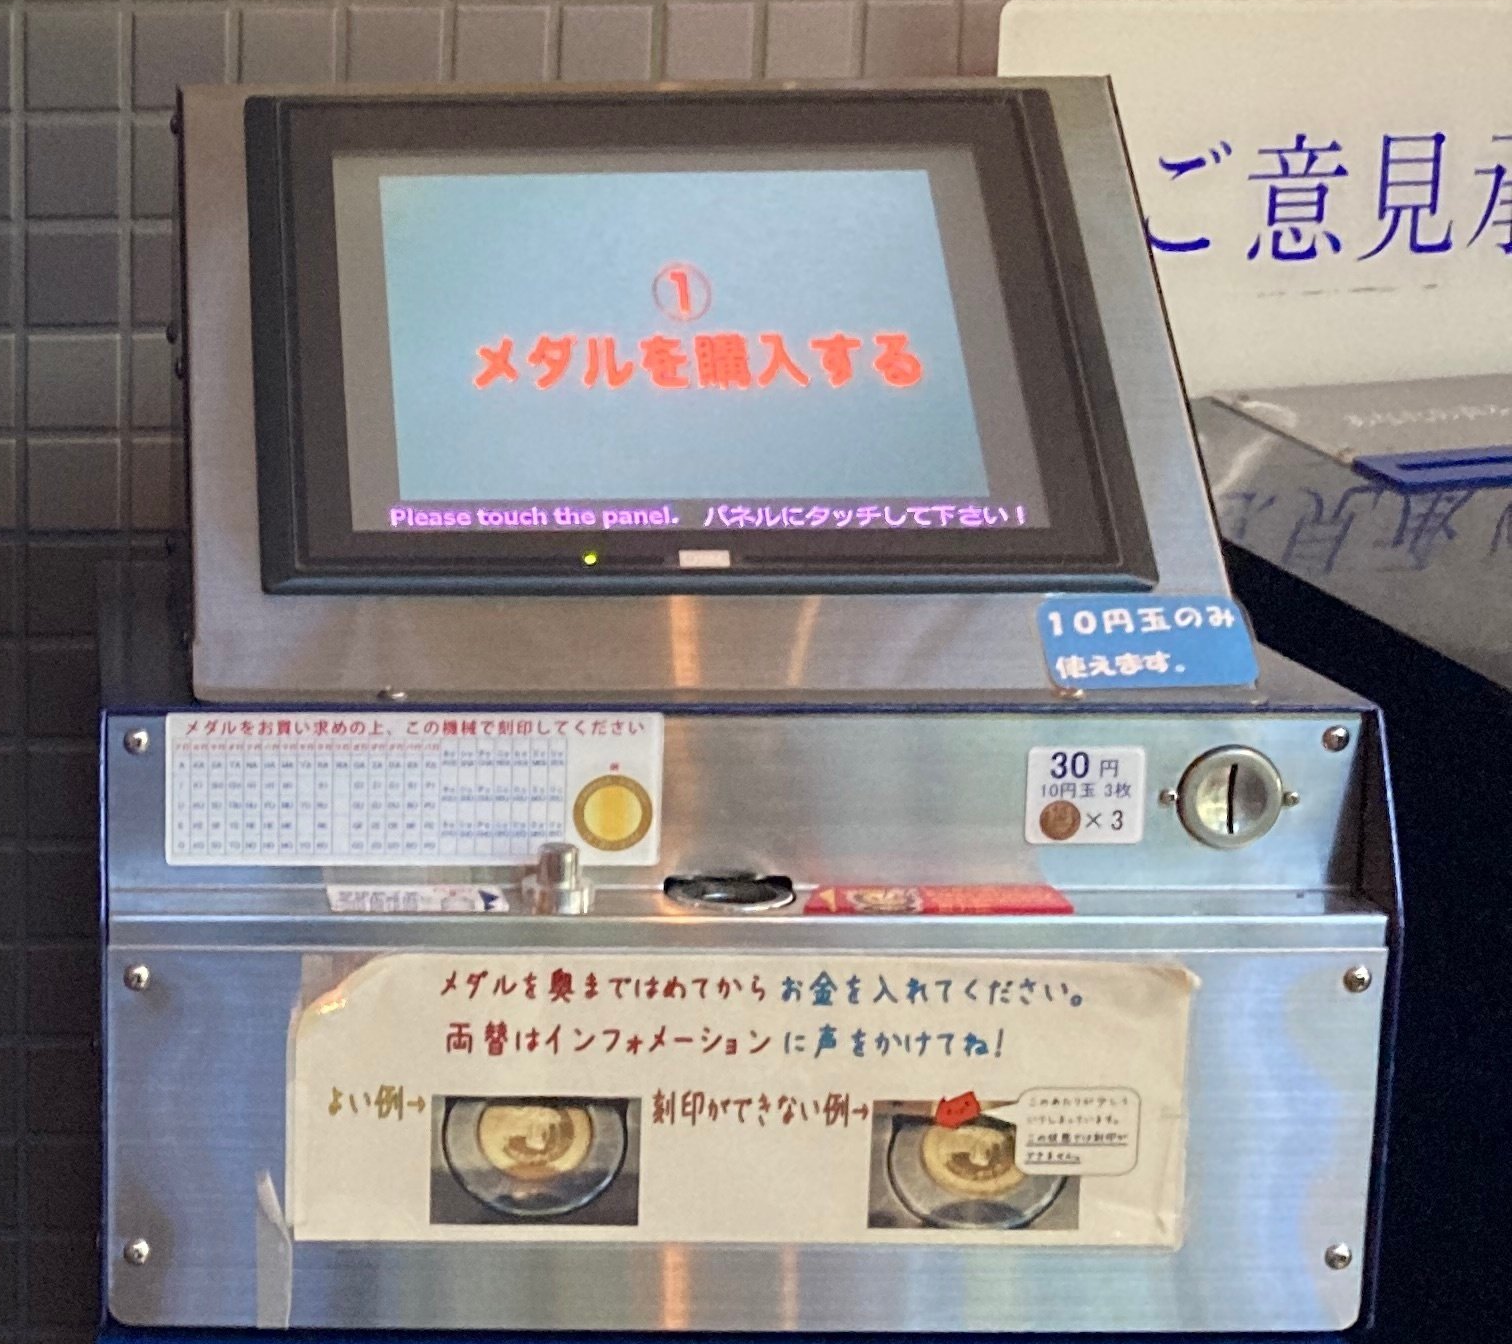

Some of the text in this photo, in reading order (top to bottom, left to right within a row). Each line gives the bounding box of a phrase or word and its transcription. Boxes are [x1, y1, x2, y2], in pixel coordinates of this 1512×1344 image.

[472, 331, 926, 392] メダルを購入する
[389, 504, 679, 532] Please touch the panel.
[703, 503, 1026, 530] パネルにタッチして下さい!
[186, 719, 644, 736] メダルをお買い求めの上、この機械で刻印してください
